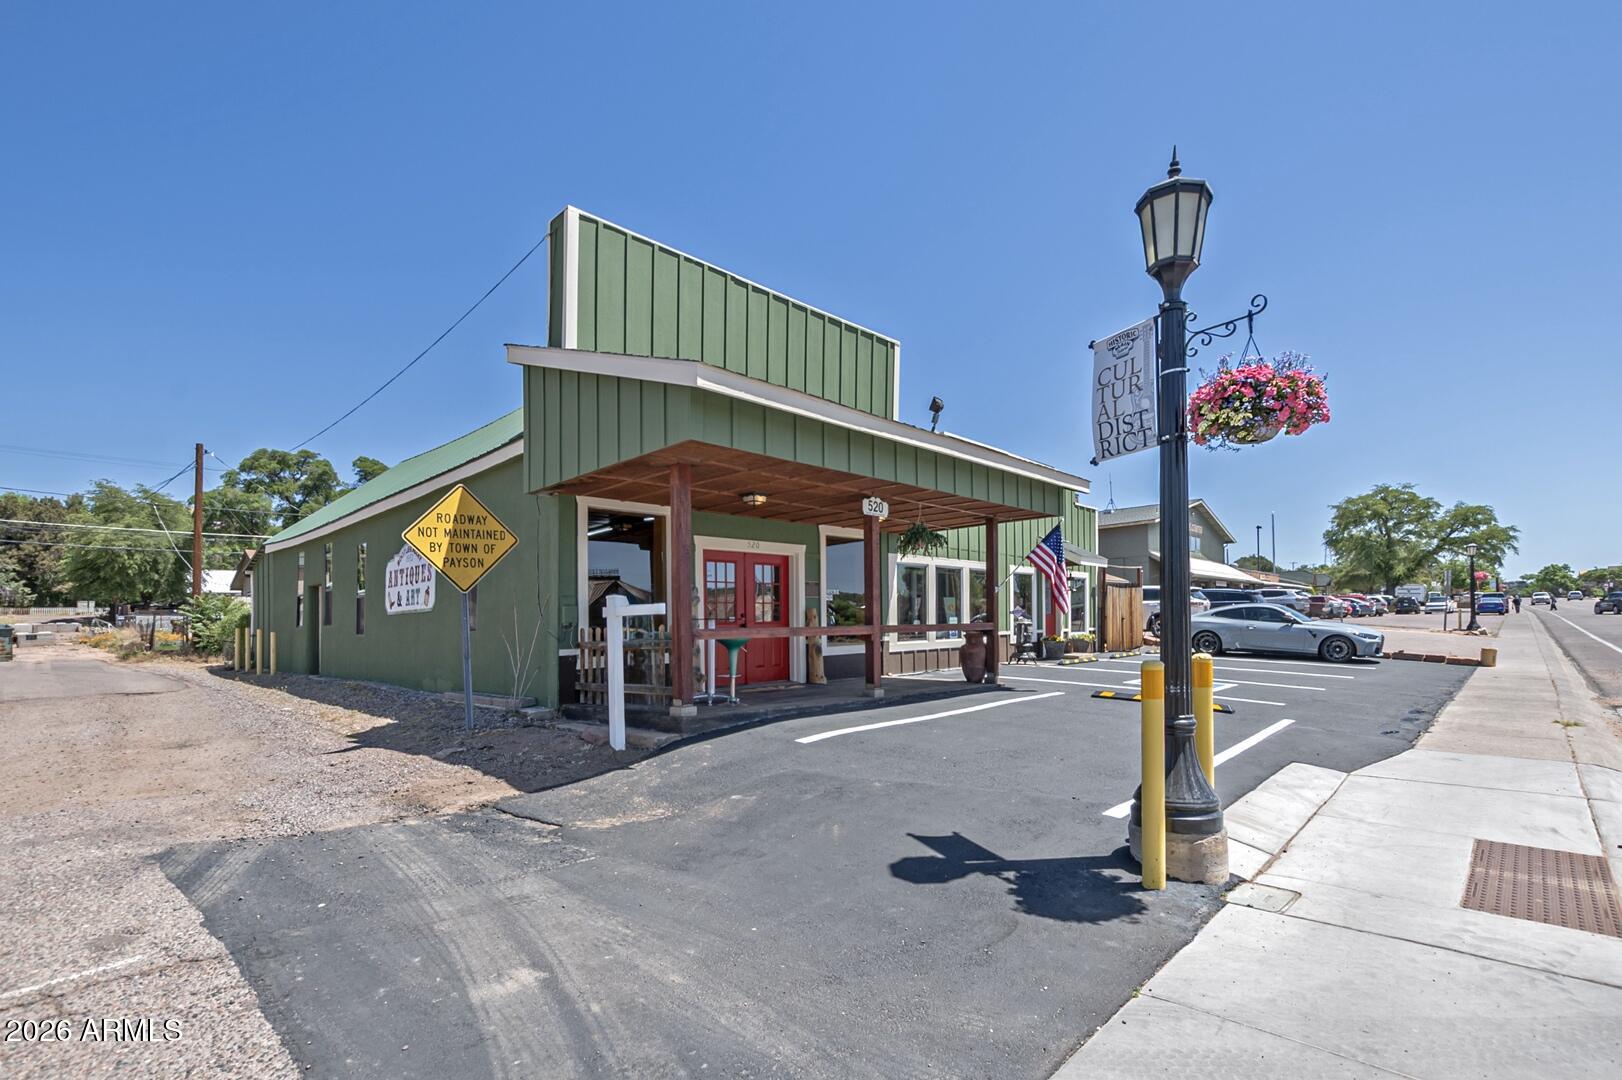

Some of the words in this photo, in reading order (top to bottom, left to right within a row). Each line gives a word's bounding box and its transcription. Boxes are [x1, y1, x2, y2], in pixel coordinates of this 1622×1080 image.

[1098, 356, 1143, 387] CUL
[1096, 374, 1143, 404] TUR
[1097, 399, 1124, 423] AL
[1098, 408, 1149, 441] DIST
[1099, 428, 1152, 459] RICT
[868, 500, 884, 513] 520
[436, 512, 488, 526] ROADWAY
[417, 526, 438, 538] NOT
[444, 528, 506, 541] MAINTAINED
[429, 542, 443, 552] BY
[449, 543, 478, 554] TOWN
[484, 544, 497, 554] OF
[443, 557, 484, 568] PAYSON
[388, 563, 432, 588] ANTIQUES
[405, 588, 420, 606] ART
